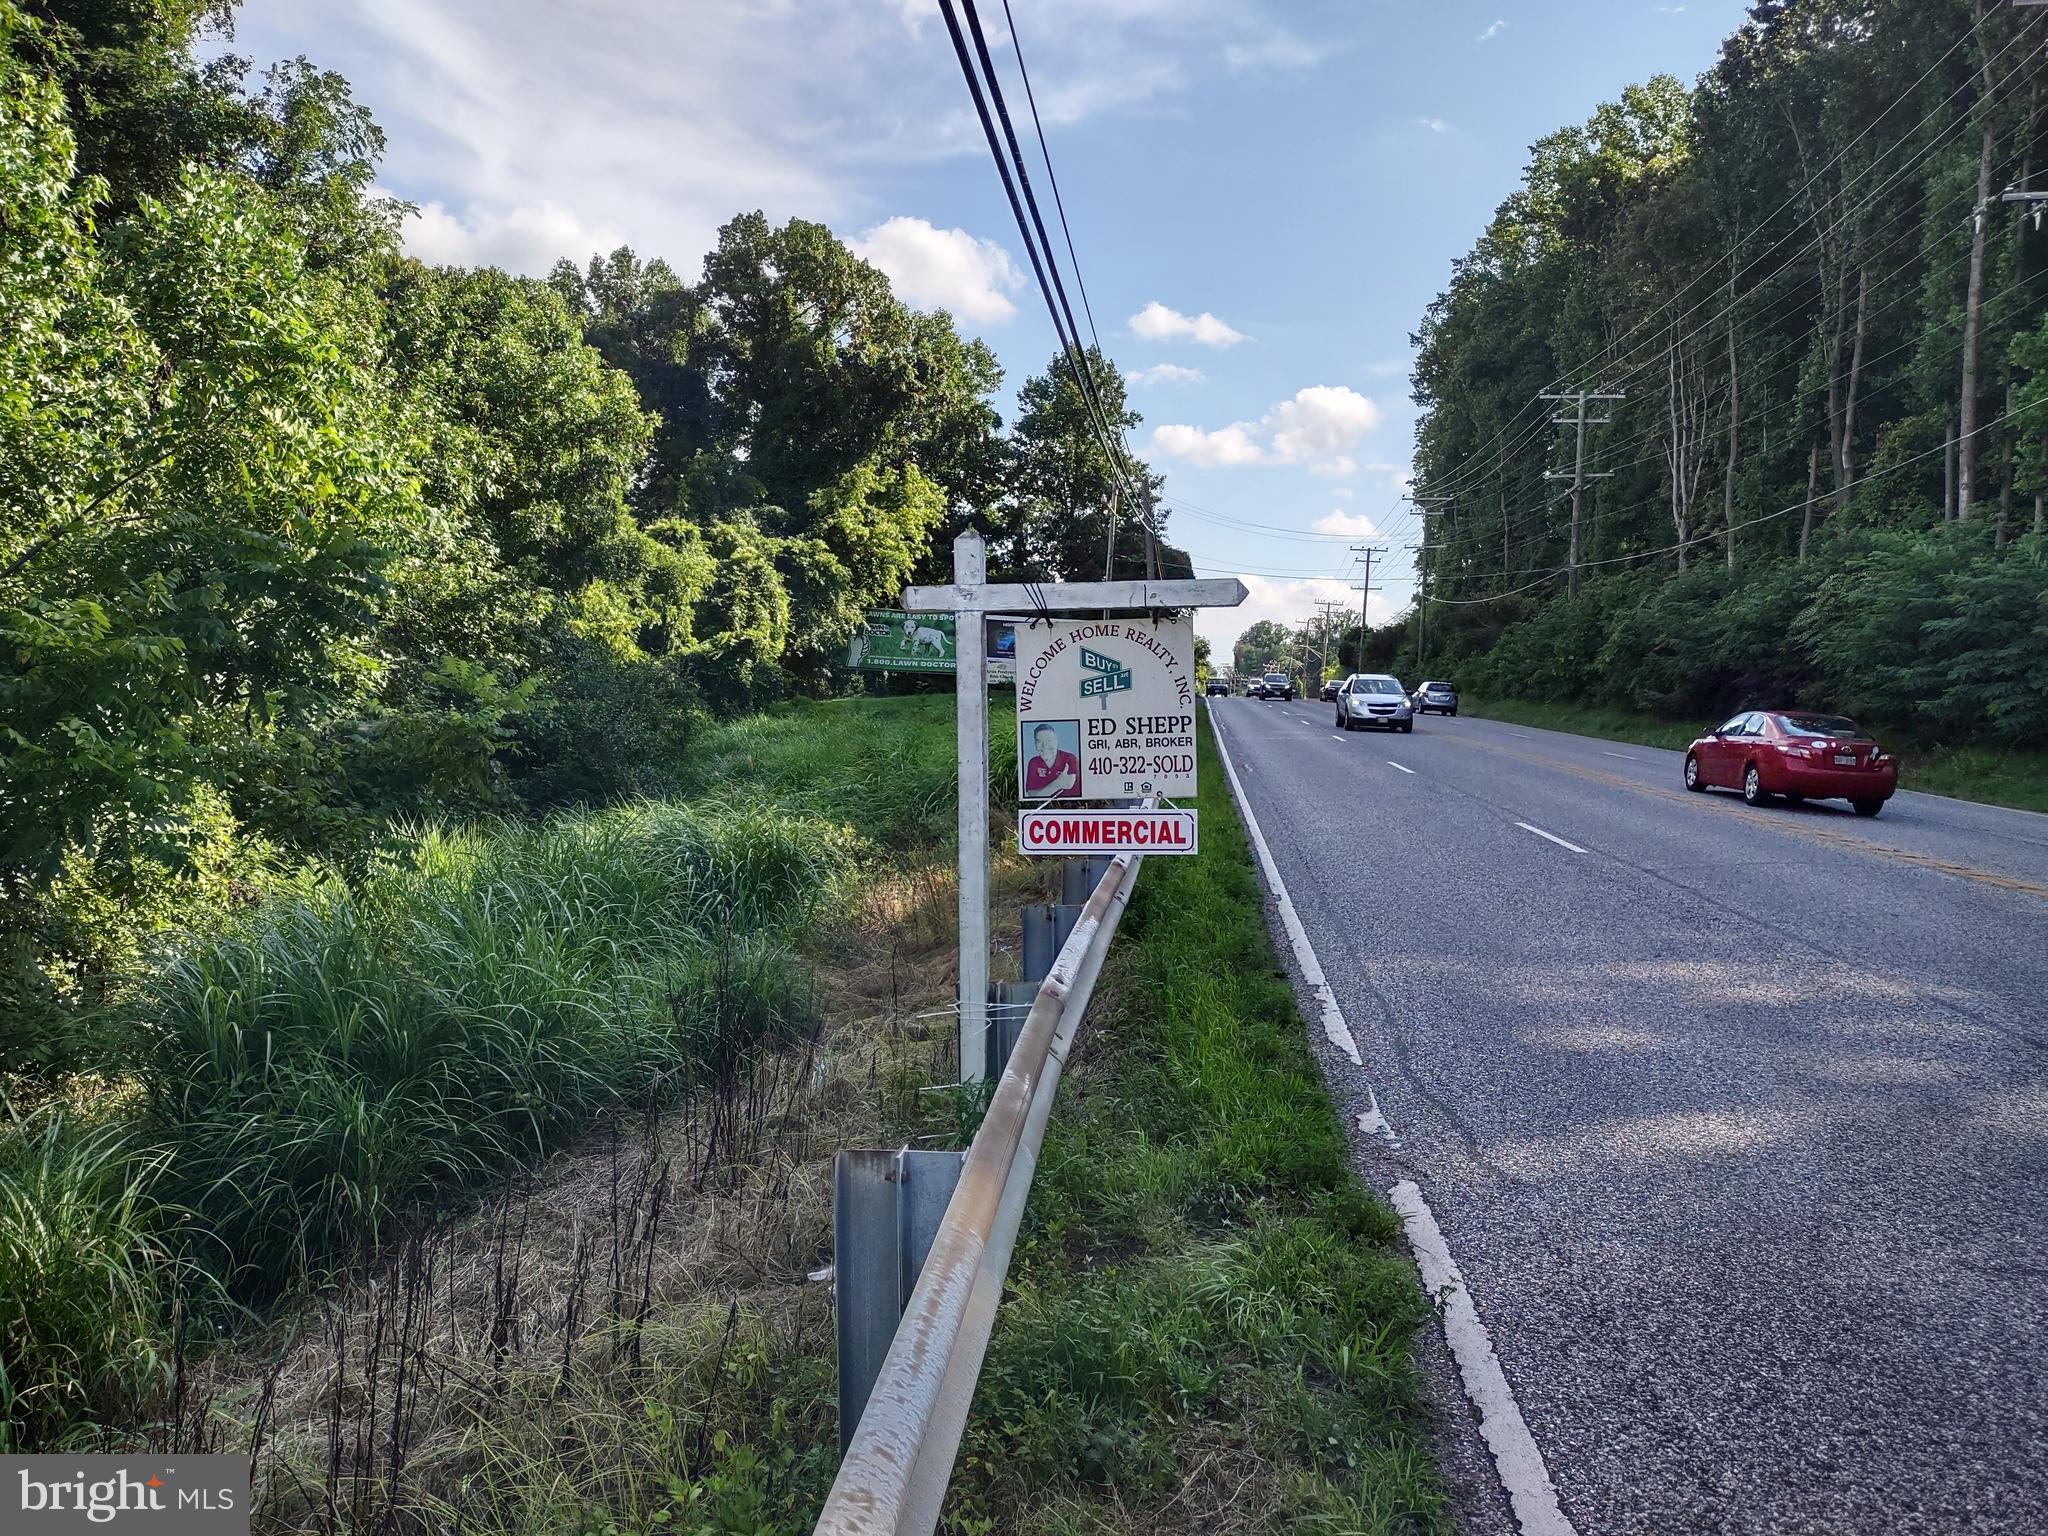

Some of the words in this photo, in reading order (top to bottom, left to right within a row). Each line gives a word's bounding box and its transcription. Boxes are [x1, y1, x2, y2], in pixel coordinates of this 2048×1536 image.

[867, 658, 918, 667] 1.800.LAWN
[920, 660, 956, 668] DOCTOR
[1020, 638, 1067, 713] WELCOME
[1069, 624, 1120, 644] HOME
[1125, 627, 1179, 674] REALTY,
[1174, 675, 1192, 709] INC.
[1085, 652, 1112, 672] BUY
[1084, 674, 1125, 695] SELL
[1088, 719, 1117, 736] ED
[1126, 716, 1192, 735] SHEPP
[1088, 739, 1110, 751] GRI,
[1115, 738, 1141, 750] ABR,
[1145, 736, 1193, 748] BROKER
[1088, 755, 1194, 775] 410-322-SOLD
[1029, 819, 1187, 845] COMMERCIAL
